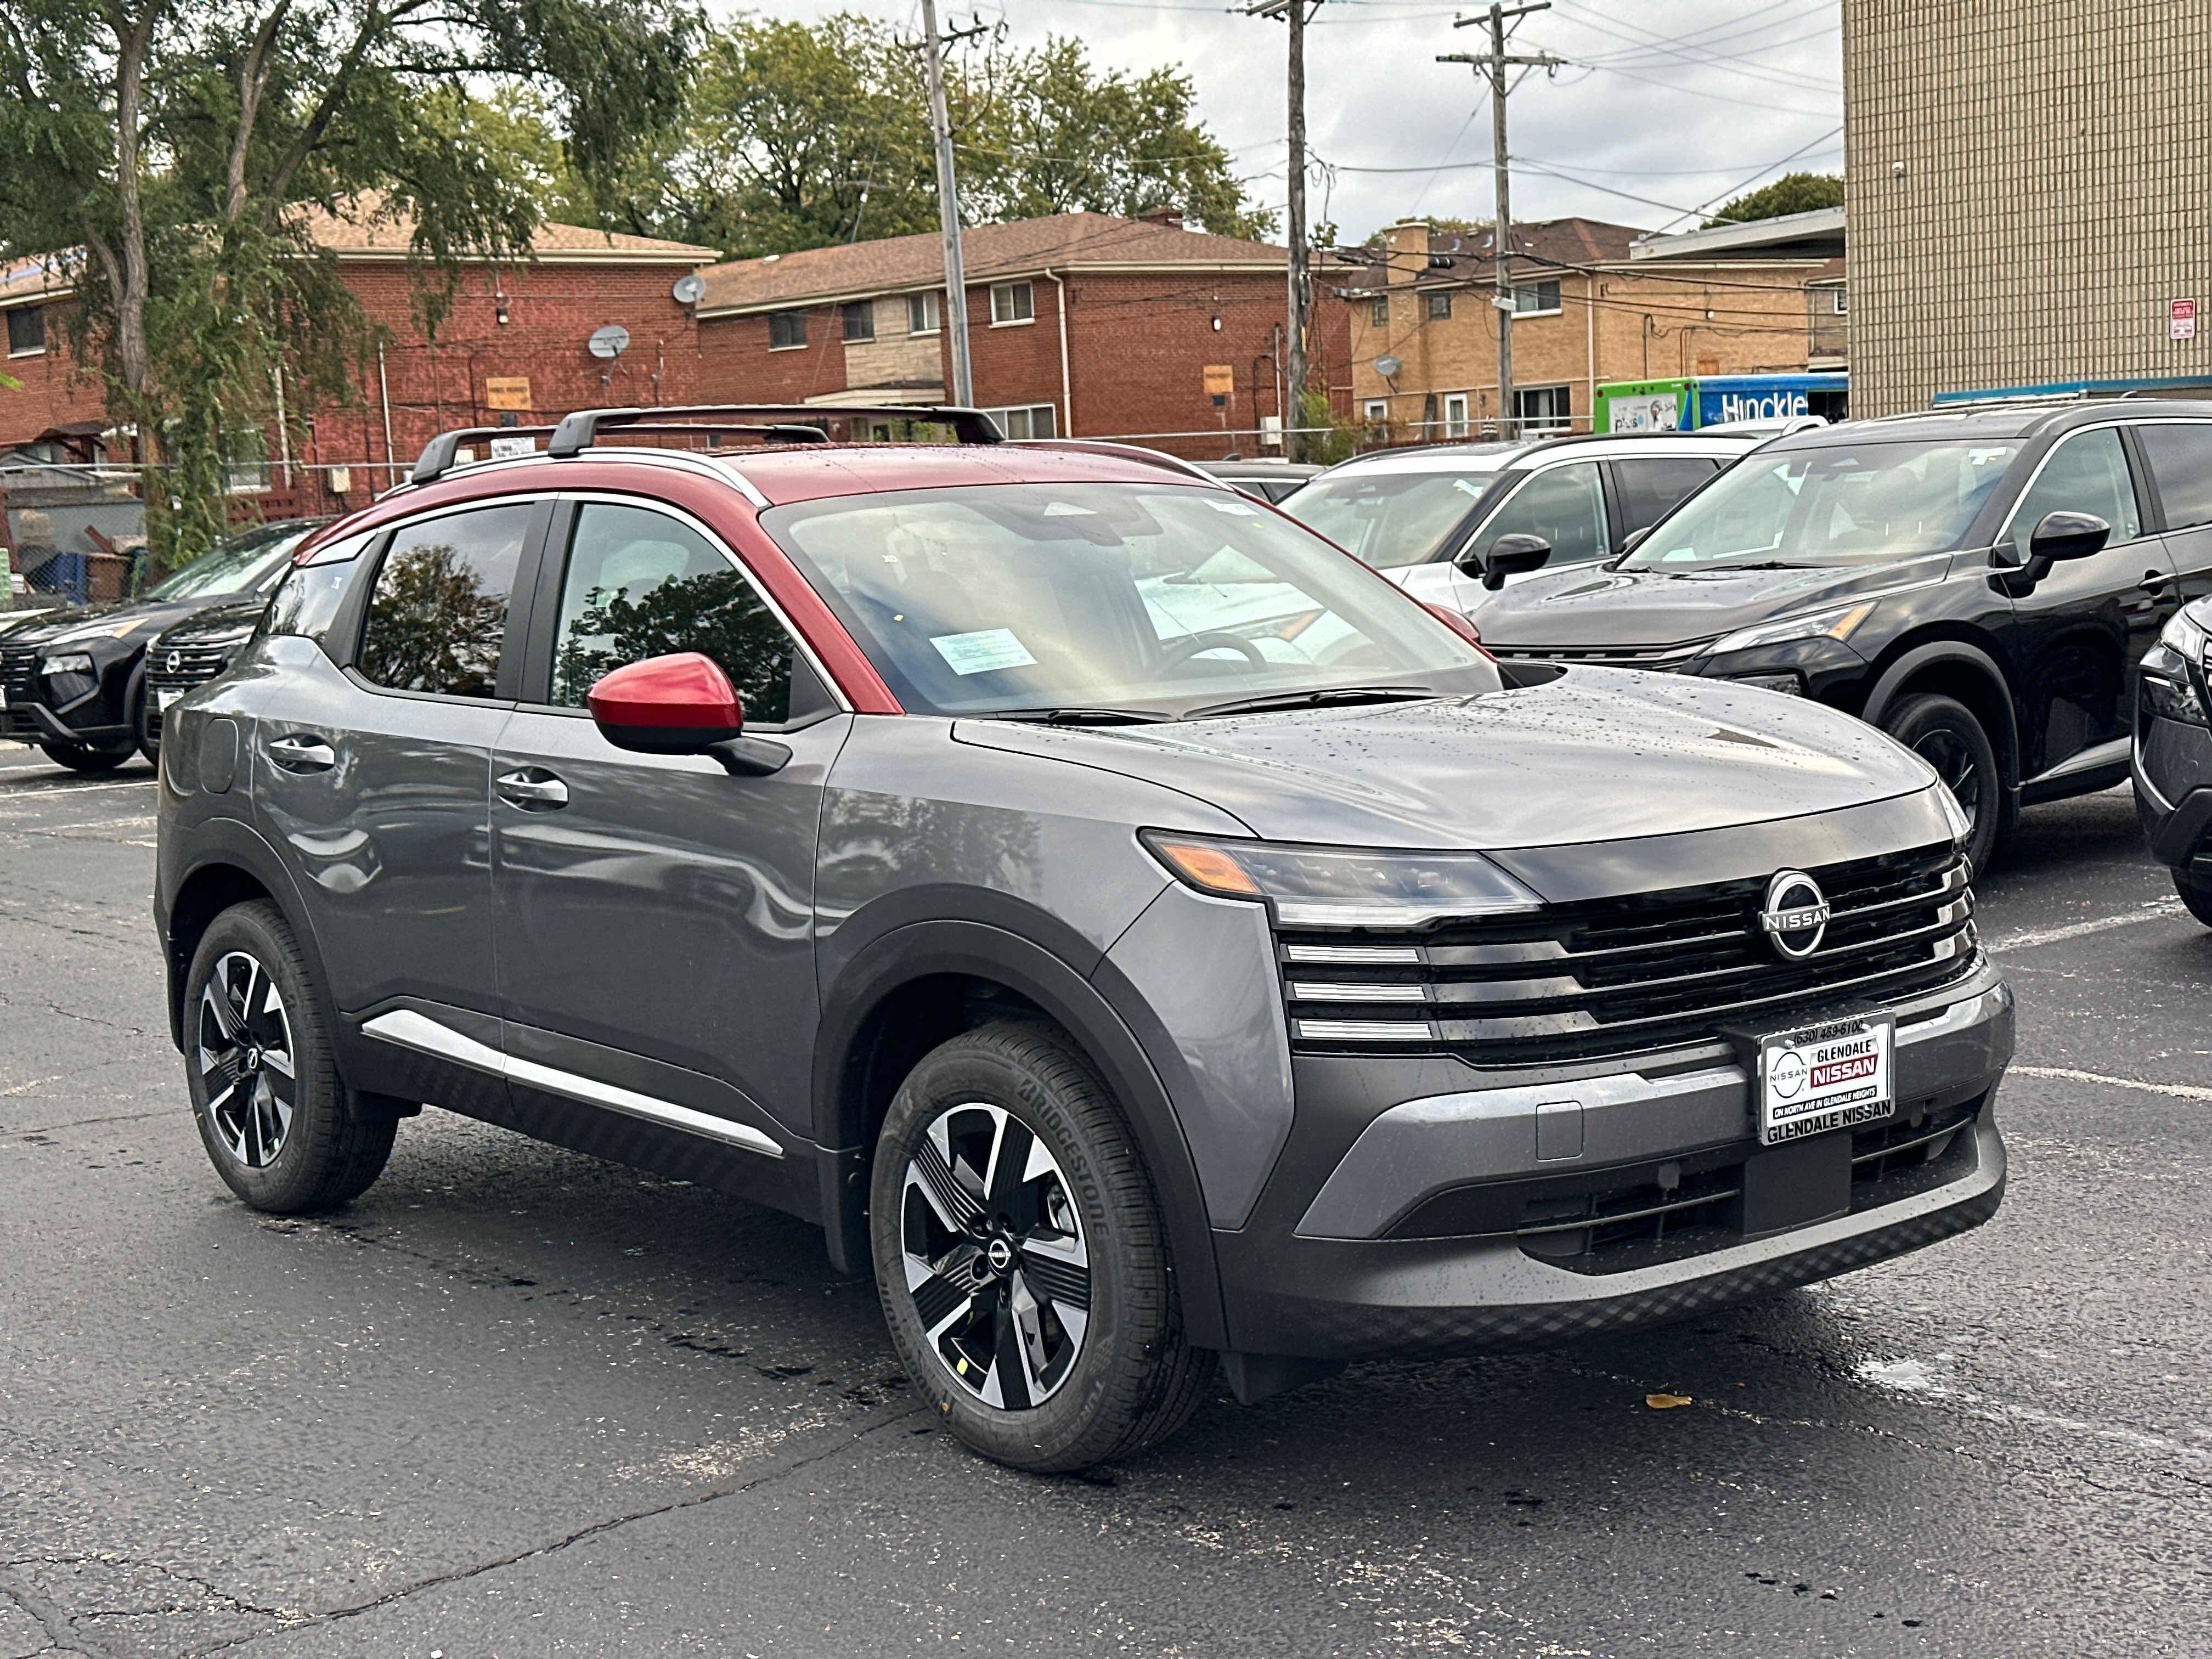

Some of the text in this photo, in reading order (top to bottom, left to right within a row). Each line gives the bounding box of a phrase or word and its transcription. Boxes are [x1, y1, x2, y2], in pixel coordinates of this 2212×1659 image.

[1722, 391, 1809, 422] Hinckle
[1765, 906, 1831, 930] NISSAN
[1794, 1019, 1864, 1045] (630) 469-6100
[1817, 1039, 1872, 1063] GLENDALE
[1770, 1068, 1808, 1083] NISSAN
[1813, 1057, 1875, 1086] NISSAN
[1775, 1087, 1876, 1118] ON NORTH AVE IN GLENDALE HEIGHTS
[1767, 1101, 1891, 1143] GLENDALE NISSAN
[1017, 1078, 1109, 1237] BRIDGESTONE
